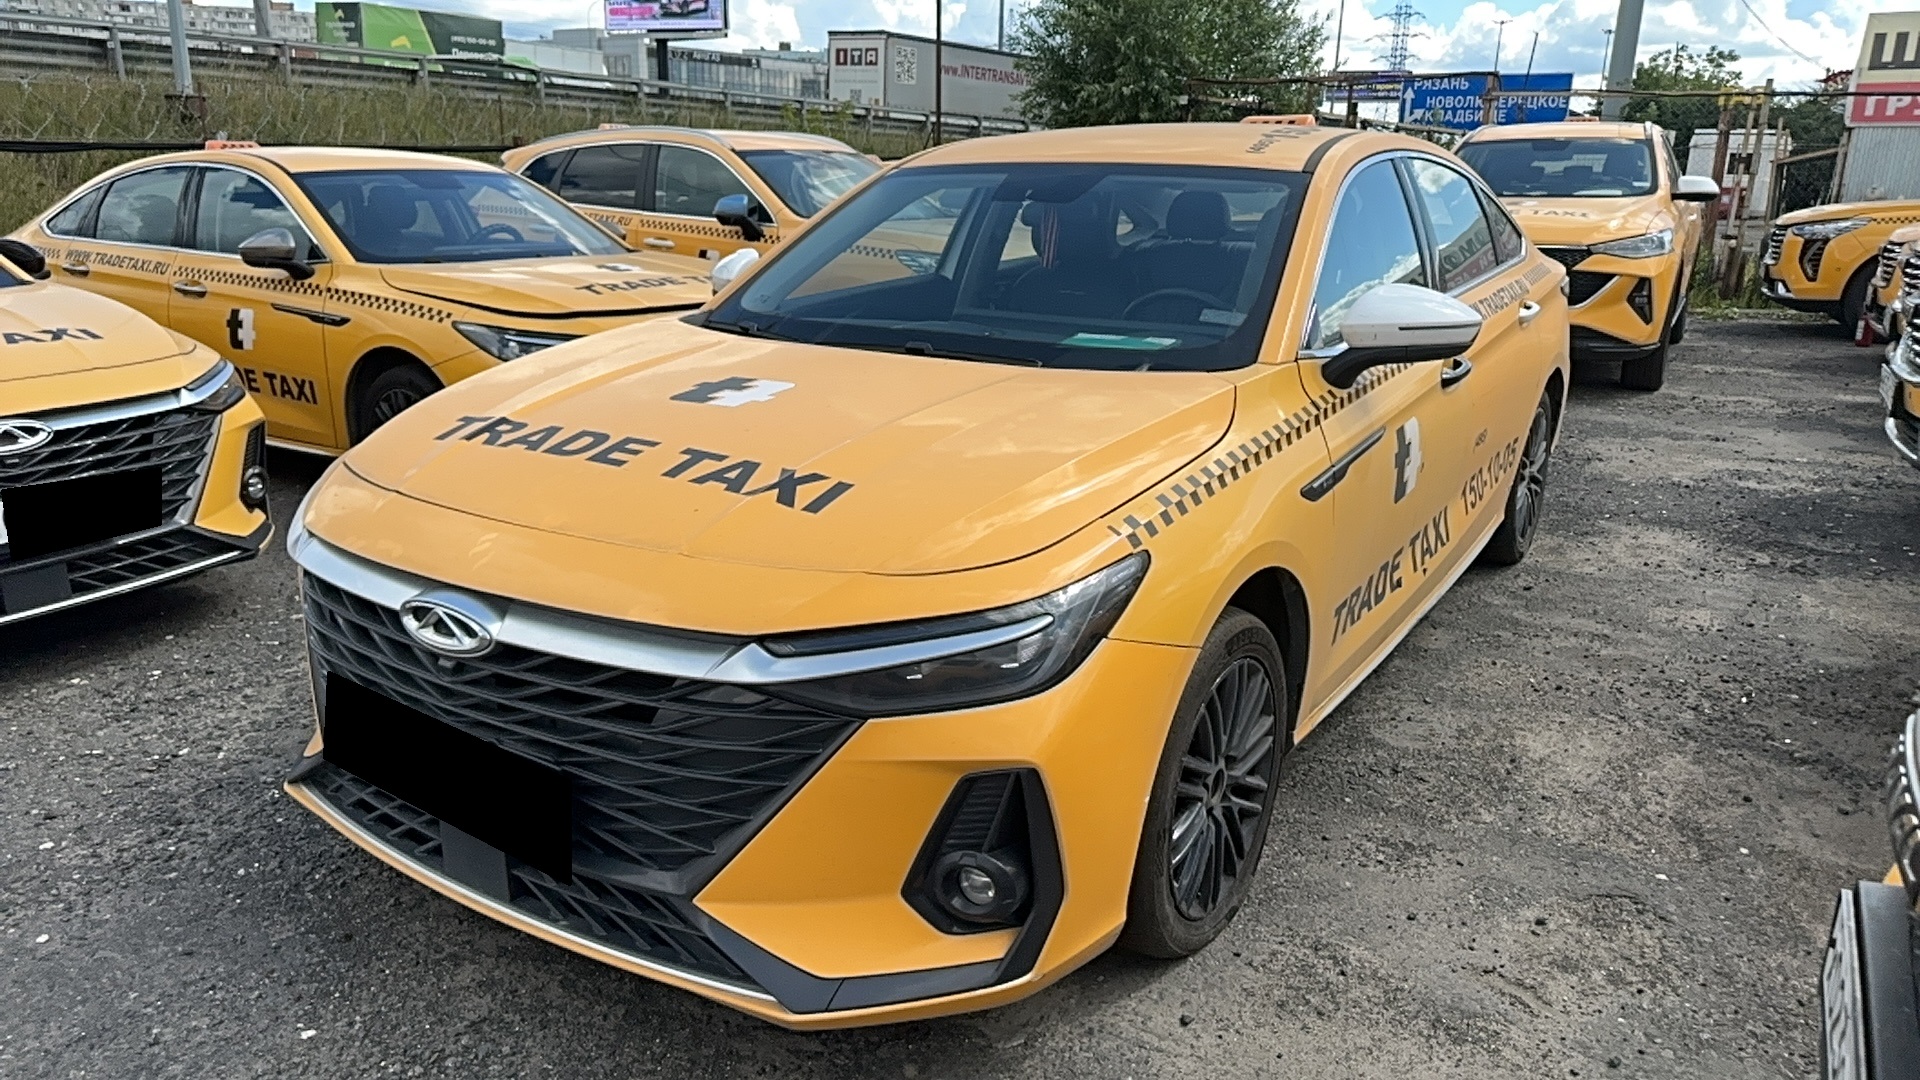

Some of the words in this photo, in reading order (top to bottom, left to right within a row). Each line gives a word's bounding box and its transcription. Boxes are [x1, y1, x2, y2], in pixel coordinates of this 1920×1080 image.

[837, 49, 877, 64] ITA
[1414, 77, 1469, 90] РЯЗАНЬ
[64, 249, 171, 275] WWW.TRADETAXI.RU
[574, 276, 687, 295] TRADE
[2, 328, 104, 345] AXI
[263, 371, 318, 405] TAXI
[433, 415, 662, 467] TRADE
[660, 447, 856, 514] TAXI
[1331, 546, 1404, 646] TRADE
[1408, 505, 1451, 574] TAXI
[1461, 436, 1520, 516] 150-10-05
